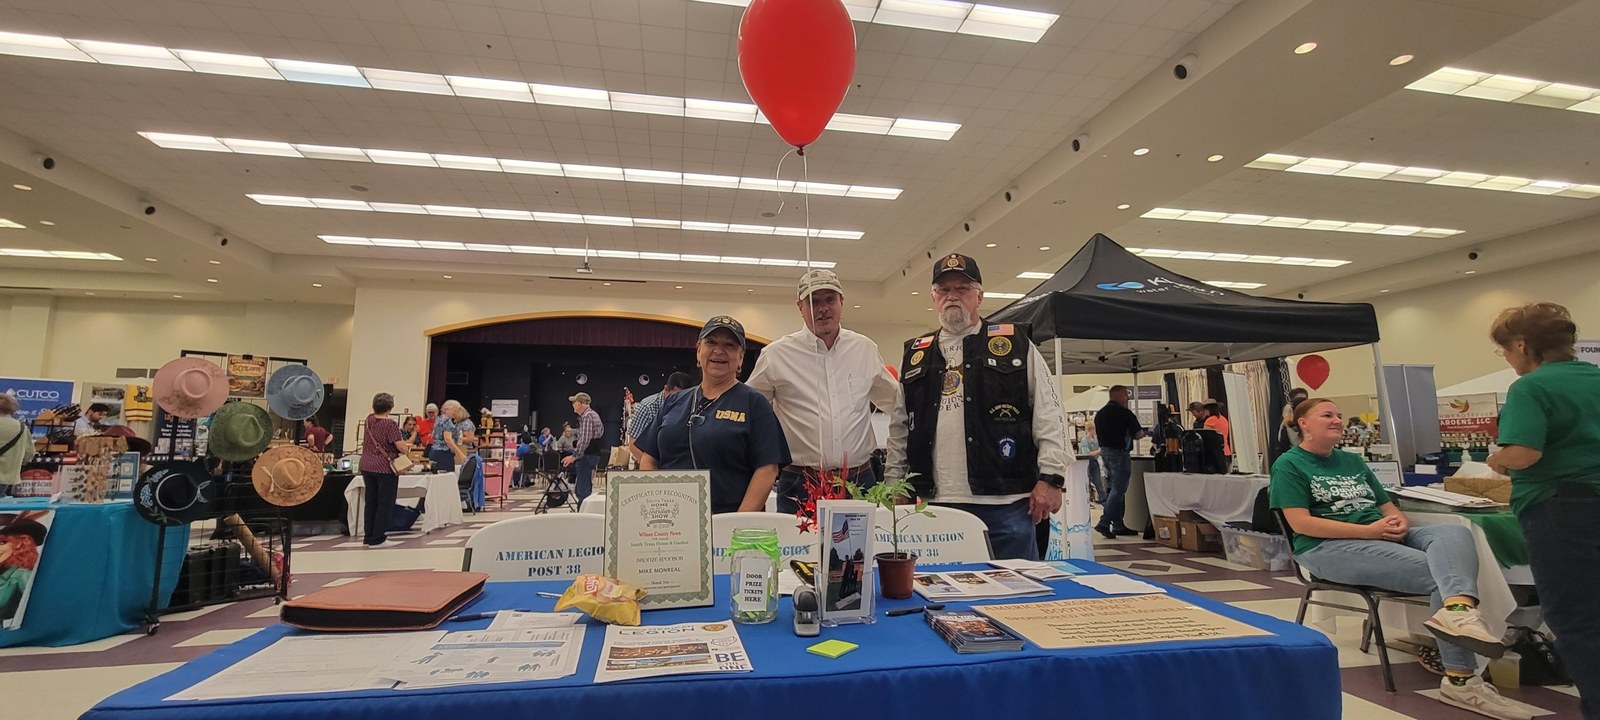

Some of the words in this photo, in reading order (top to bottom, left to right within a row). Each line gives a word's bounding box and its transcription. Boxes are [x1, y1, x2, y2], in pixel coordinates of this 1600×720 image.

[16, 389, 59, 399] CUTCO
[1476, 417, 1491, 425] LLC
[621, 490, 654, 507] CERTIFICATE
[663, 489, 698, 505] RECOGNITION
[926, 532, 965, 543] LEGION
[496, 548, 564, 561] AMERICAN
[567, 546, 604, 558] LEGIO
[926, 548, 939, 557] 38
[528, 565, 562, 577] POST
[566, 564, 581, 575] 38
[619, 627, 695, 636] LEGION
[714, 650, 746, 663] BE
